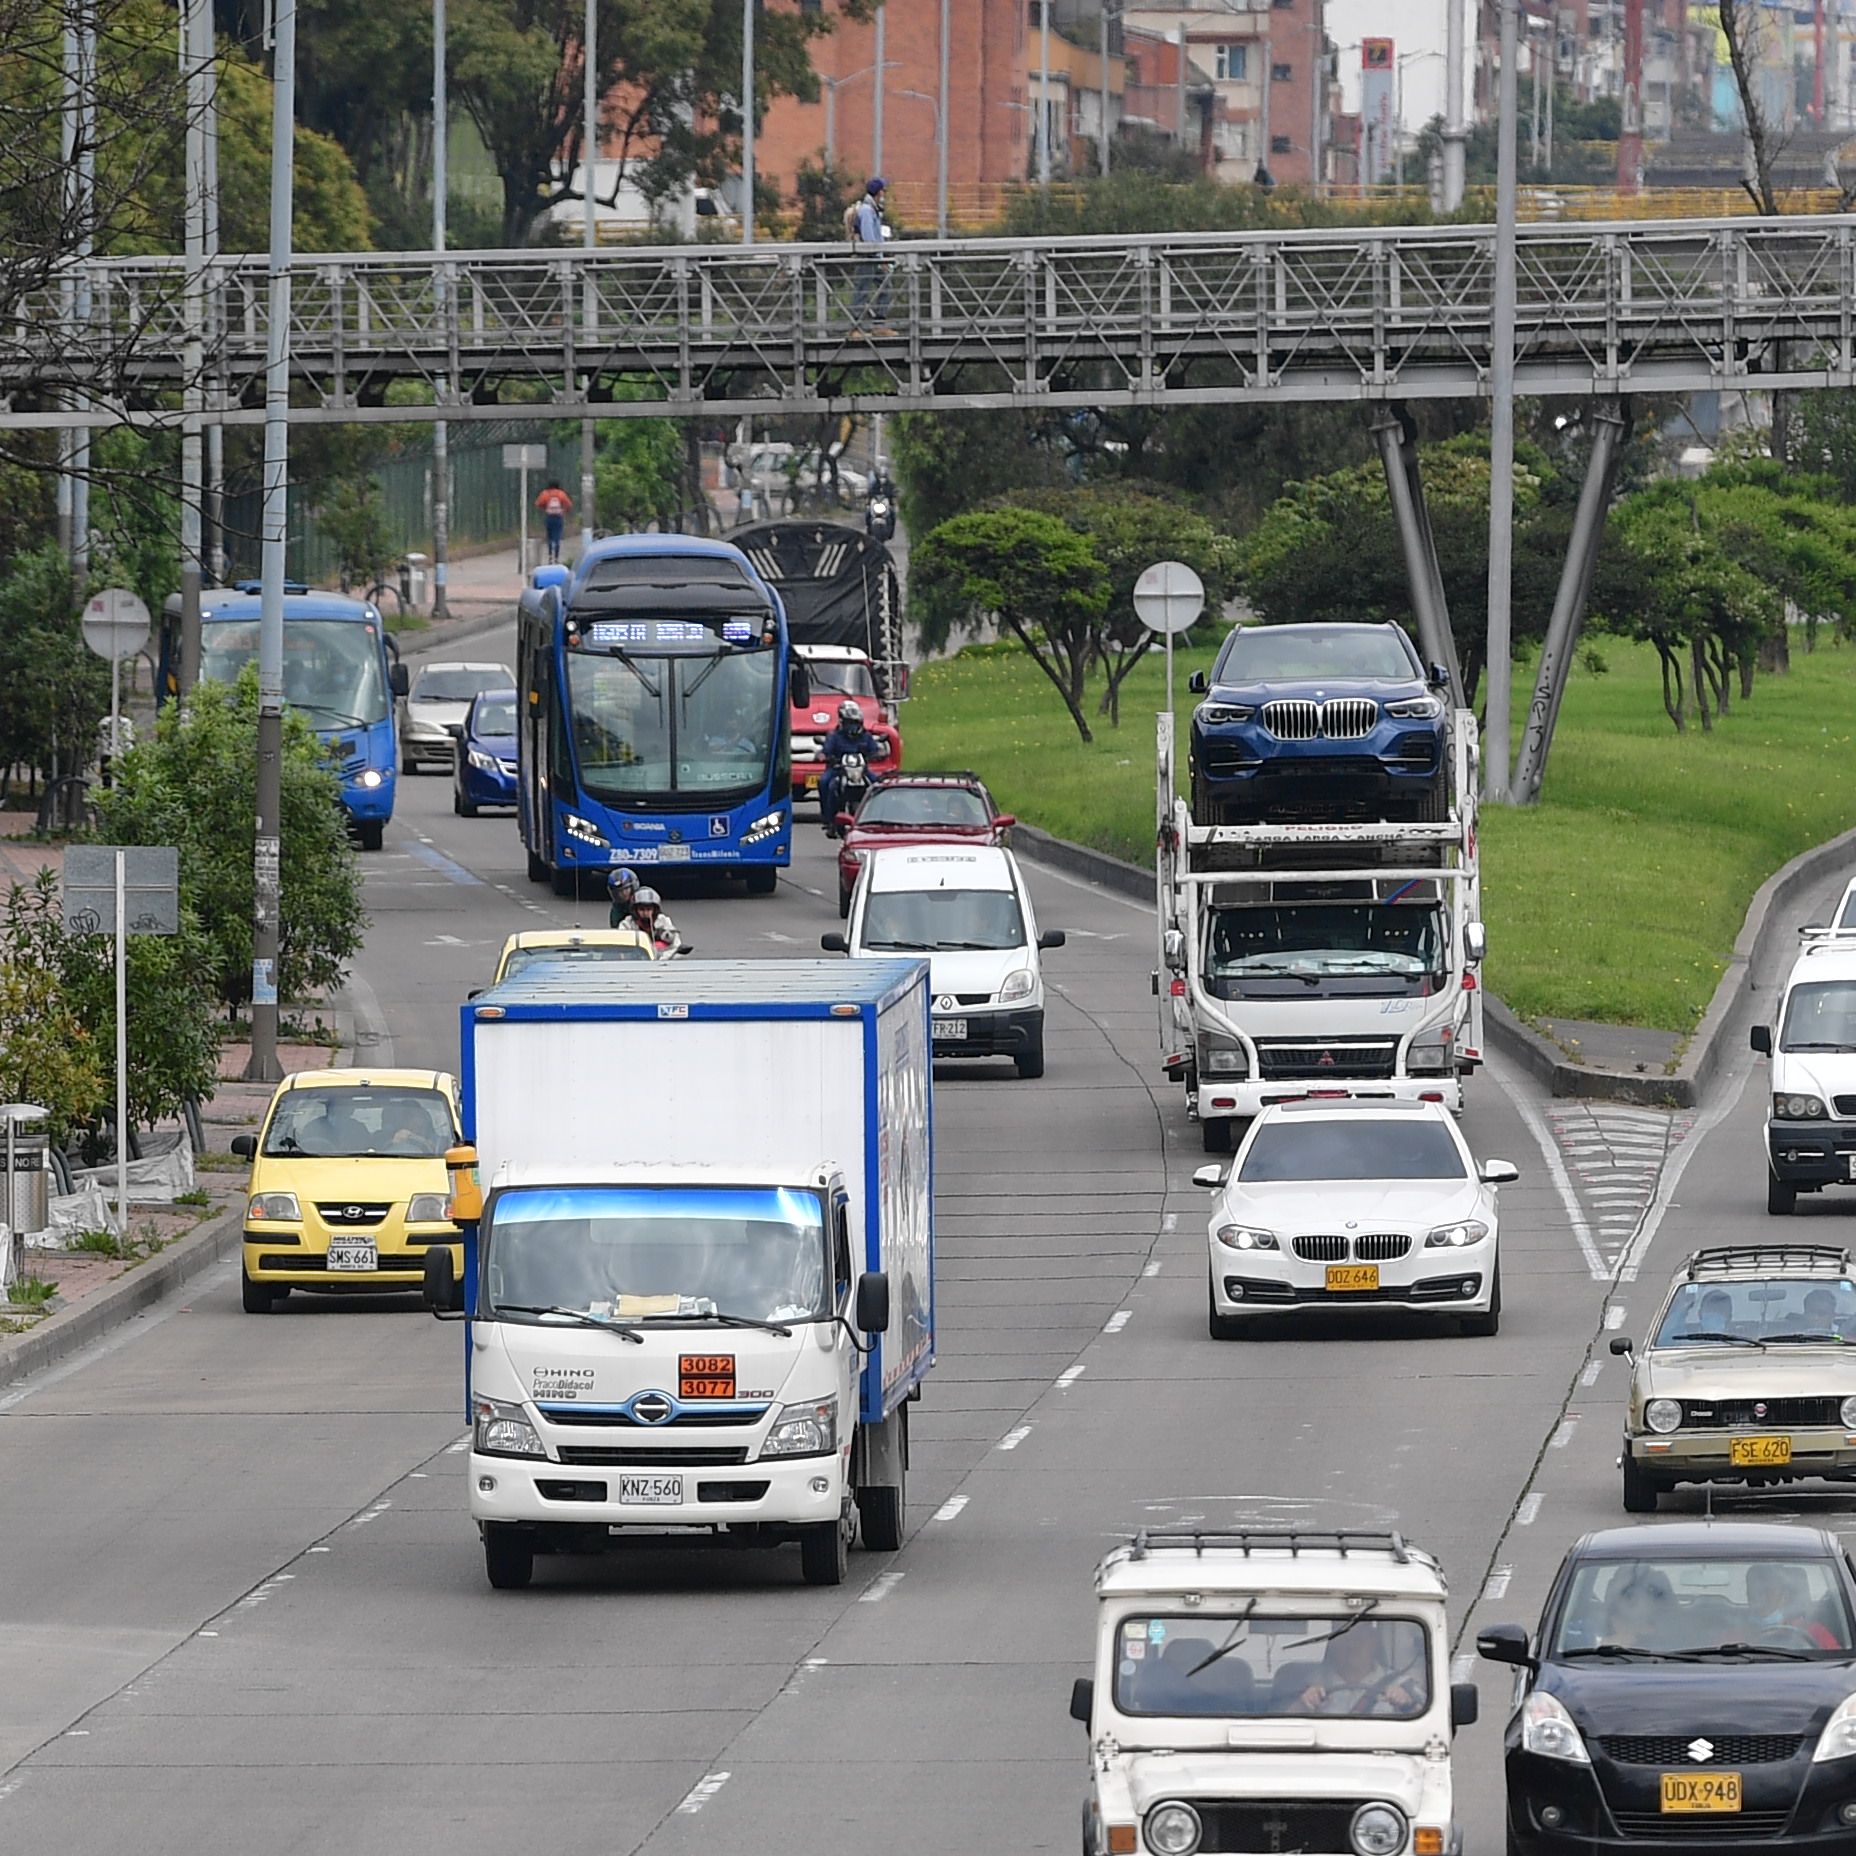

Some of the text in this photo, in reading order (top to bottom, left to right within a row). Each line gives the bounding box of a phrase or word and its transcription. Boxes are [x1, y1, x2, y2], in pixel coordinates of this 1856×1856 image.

[683, 1357, 732, 1373] 3082
[550, 1369, 595, 1378] HINO
[683, 1380, 732, 1396] 3077
[533, 1390, 577, 1400] HINO
[737, 1389, 776, 1399] 300
